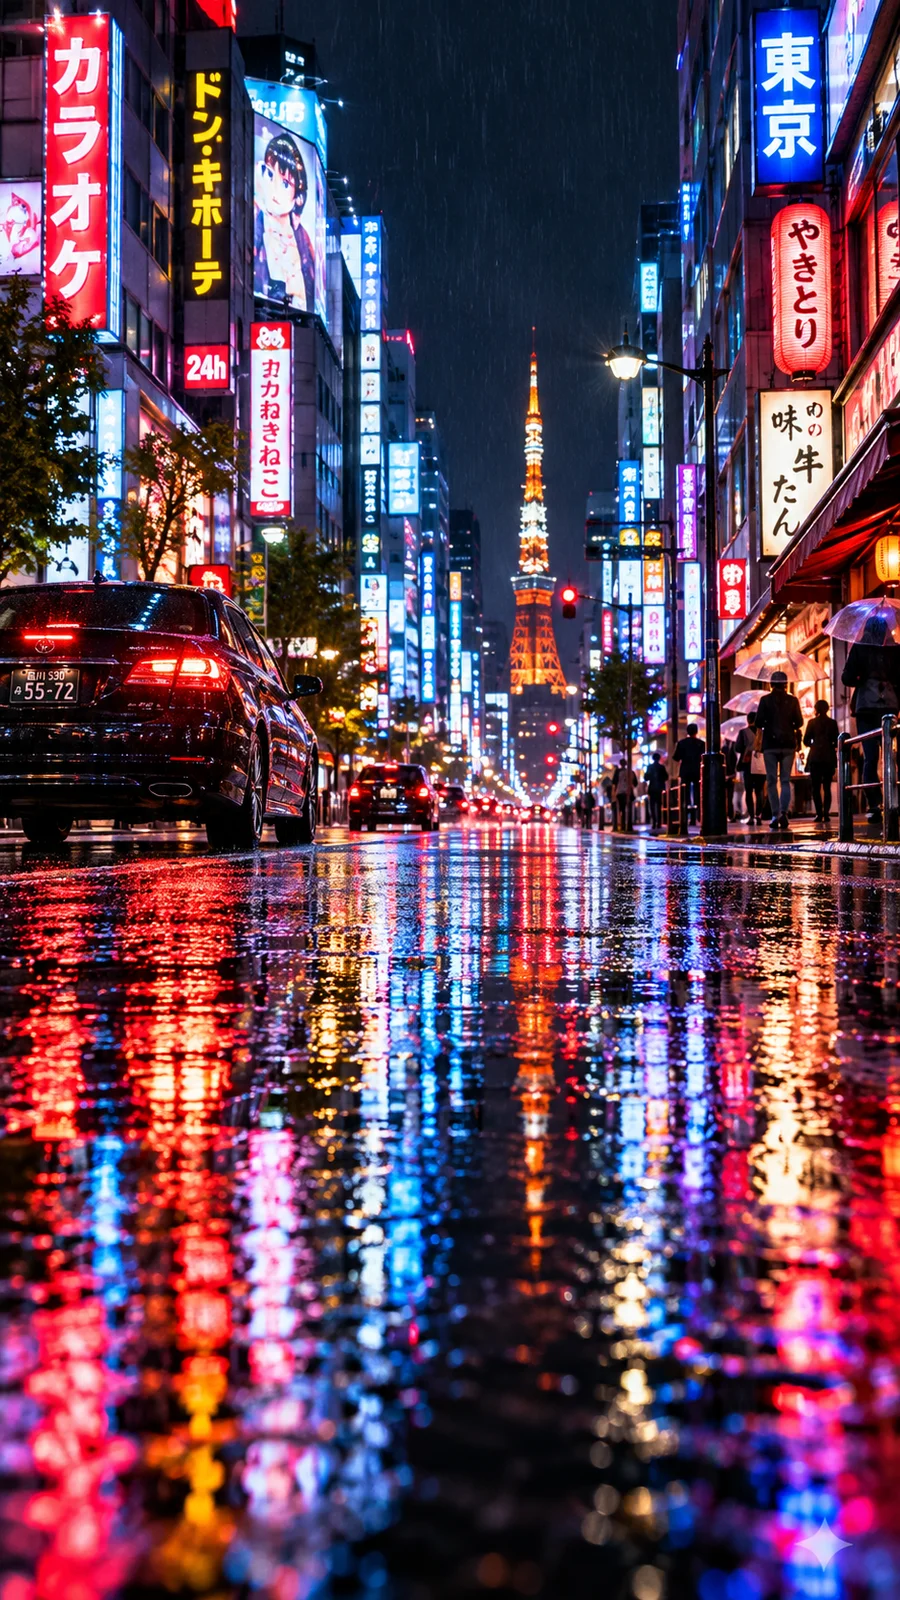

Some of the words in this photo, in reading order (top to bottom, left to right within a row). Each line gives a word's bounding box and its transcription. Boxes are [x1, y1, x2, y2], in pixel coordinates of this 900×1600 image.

[761, 32, 817, 159] 東京
[49, 37, 102, 299] カラオケ
[190, 71, 223, 296] ドン・キホーテ
[788, 219, 821, 349] やきとり
[186, 353, 227, 381] 24h
[24, 682, 74, 700] 55-72
